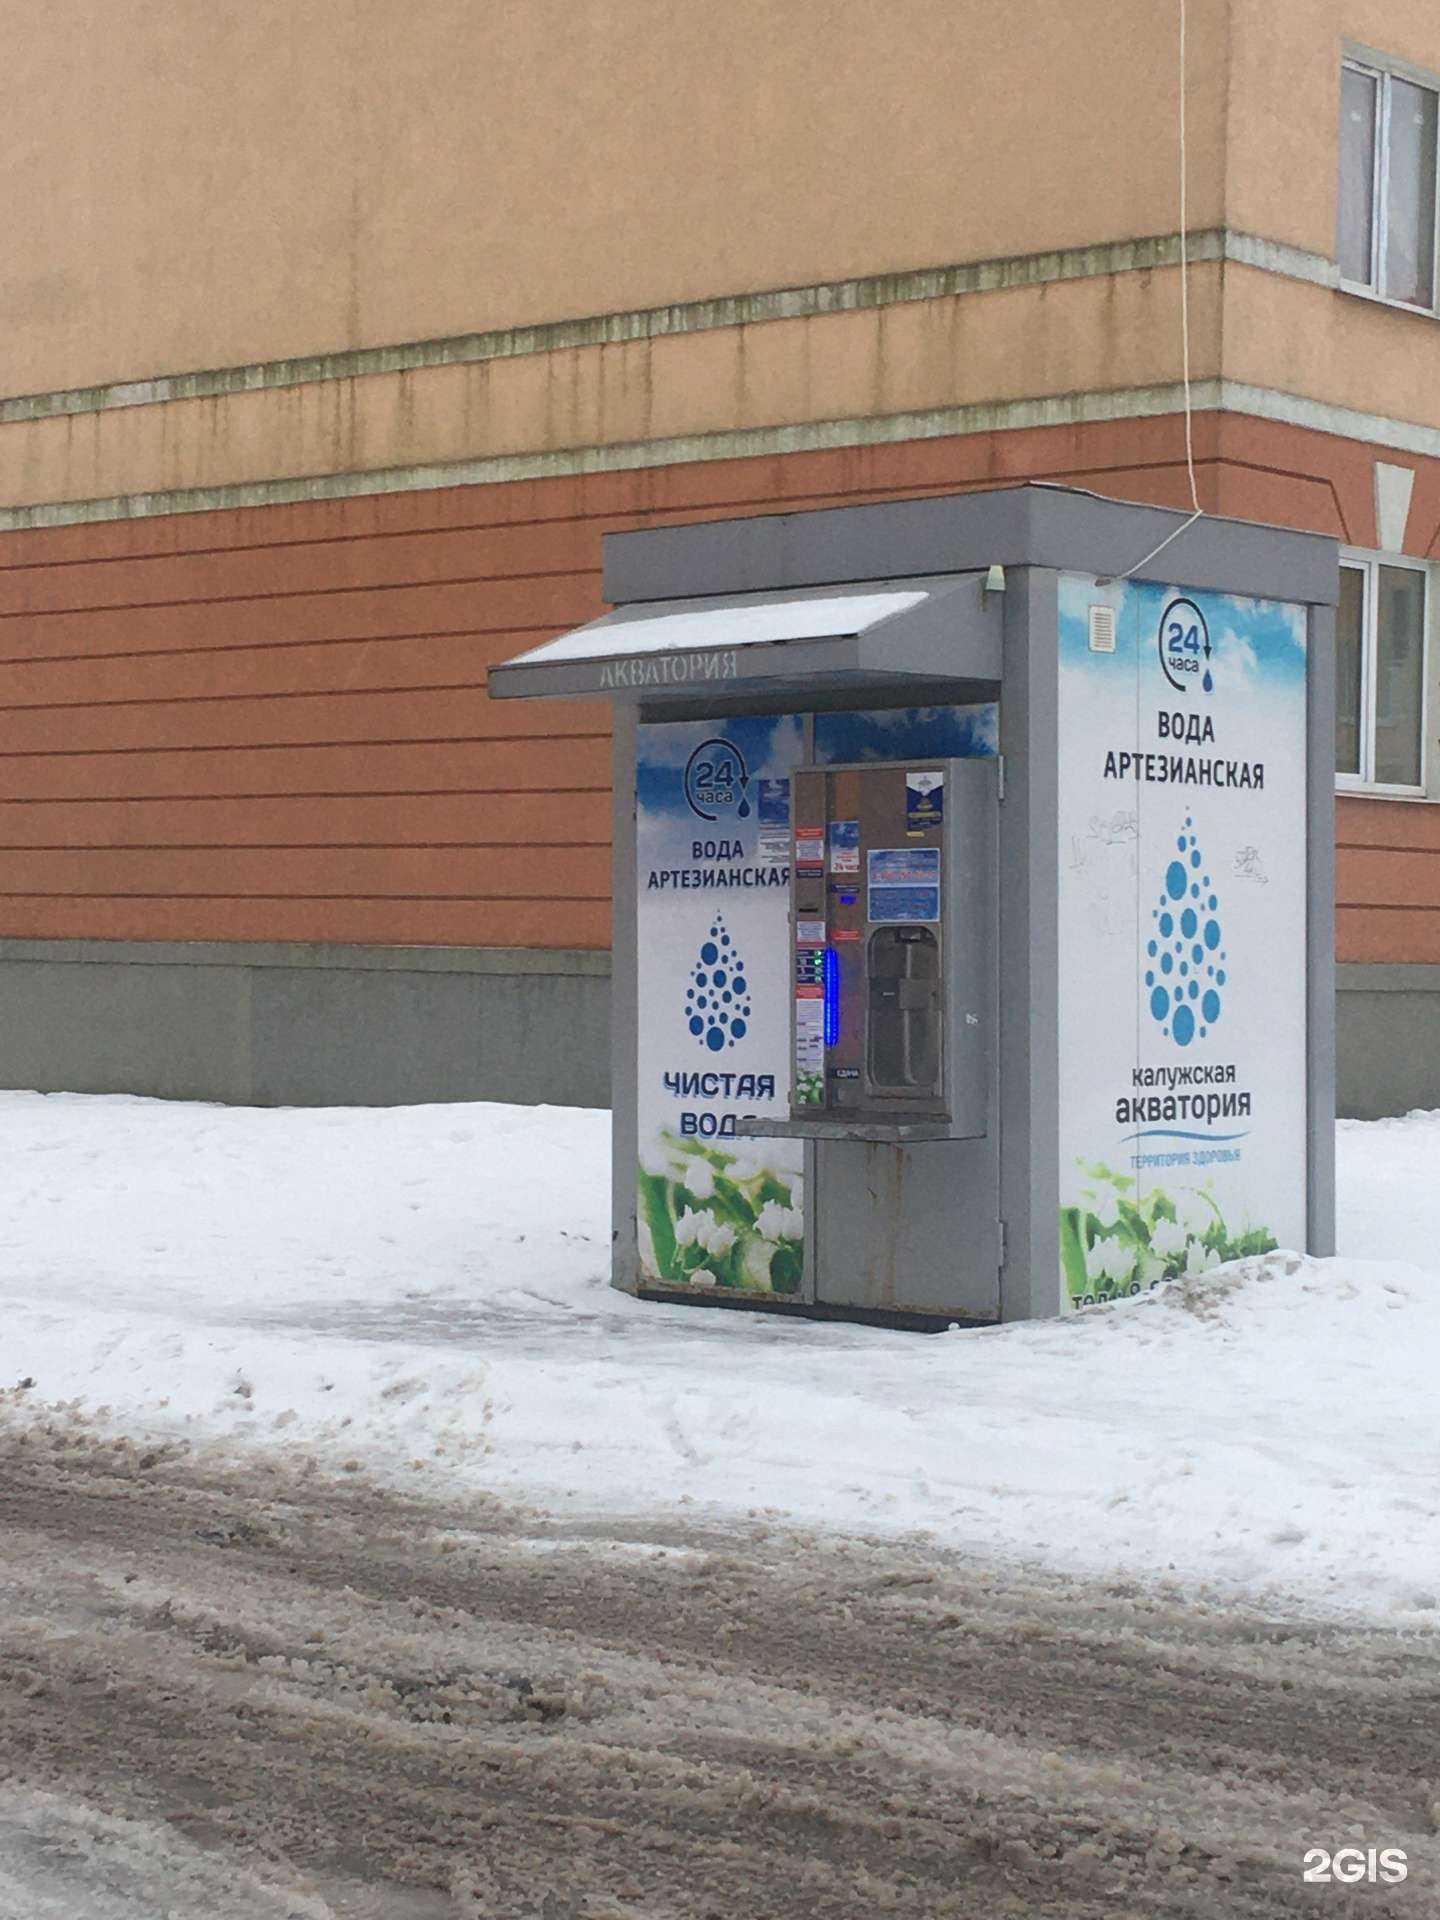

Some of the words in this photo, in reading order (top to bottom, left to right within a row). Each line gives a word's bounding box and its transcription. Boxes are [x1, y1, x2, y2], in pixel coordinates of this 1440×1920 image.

[1168, 622, 1201, 654] 24
[600, 650, 737, 688] АКВАТОРИЯ
[1168, 656, 1200, 673] часа
[1158, 711, 1215, 745] ВОДА
[695, 761, 734, 788] 24
[1103, 751, 1265, 790] АРТЕЗИАНСКАЯ
[697, 791, 733, 804] часа
[692, 840, 744, 862] ВОДА
[648, 867, 790, 889] АРТЕЗИАНСКАЯ
[664, 1071, 775, 1100] ЧИСТАЯ
[1132, 1064, 1236, 1091] калужская
[1115, 1092, 1251, 1125] акватория
[680, 1112, 757, 1138] ВОД
[1130, 1152, 1190, 1169] ТЕРРИТОРИЯ
[1193, 1149, 1241, 1167] ЗДОРОВЬЯ
